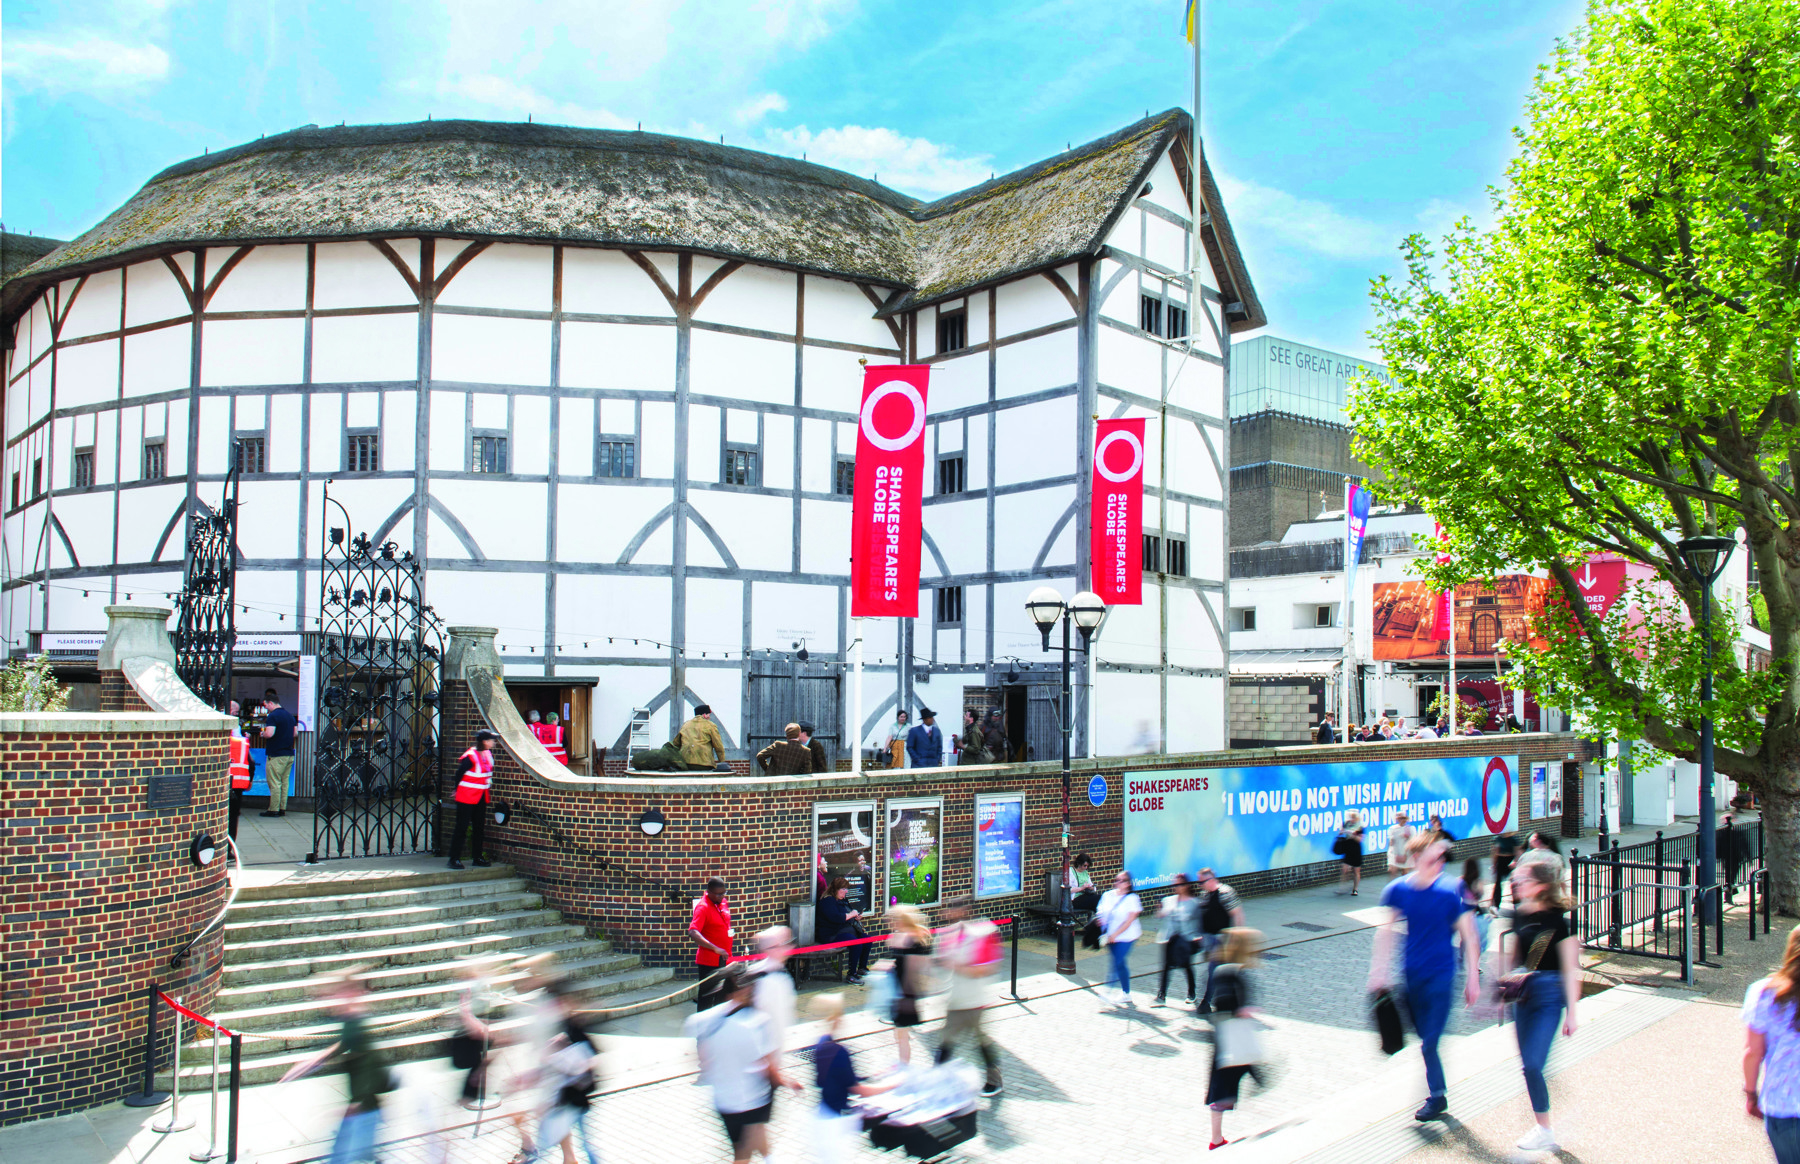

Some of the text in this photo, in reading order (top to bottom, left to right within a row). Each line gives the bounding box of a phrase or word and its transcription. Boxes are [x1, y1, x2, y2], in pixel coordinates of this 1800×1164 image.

[1270, 345, 1291, 366] SEE
[1295, 351, 1332, 376] GREAT
[1335, 362, 1357, 379] ART
[873, 466, 889, 523] GLOBE
[1106, 493, 1117, 536] GLOBE
[884, 466, 903, 601] SHAKESPEARE'S
[1116, 493, 1128, 593] SHAKESPEARE'S
[1583, 595, 1606, 603] IDED
[1129, 777, 1209, 795] SHAKESPEARE'S
[1128, 796, 1164, 812] GLOBE
[1239, 788, 1302, 815] WOULD
[1307, 785, 1340, 810] NOT
[1343, 783, 1381, 806] WISH
[1383, 781, 1412, 802] ANY
[979, 805, 1006, 813] SUMMER
[979, 812, 996, 821] 2022
[1288, 797, 1469, 838] COMPAON IN THE WORLD
[909, 819, 927, 827] MUCH
[909, 831, 930, 839] ABOUT
[909, 836, 935, 845] NOTHING
[1368, 829, 1389, 852] BU
